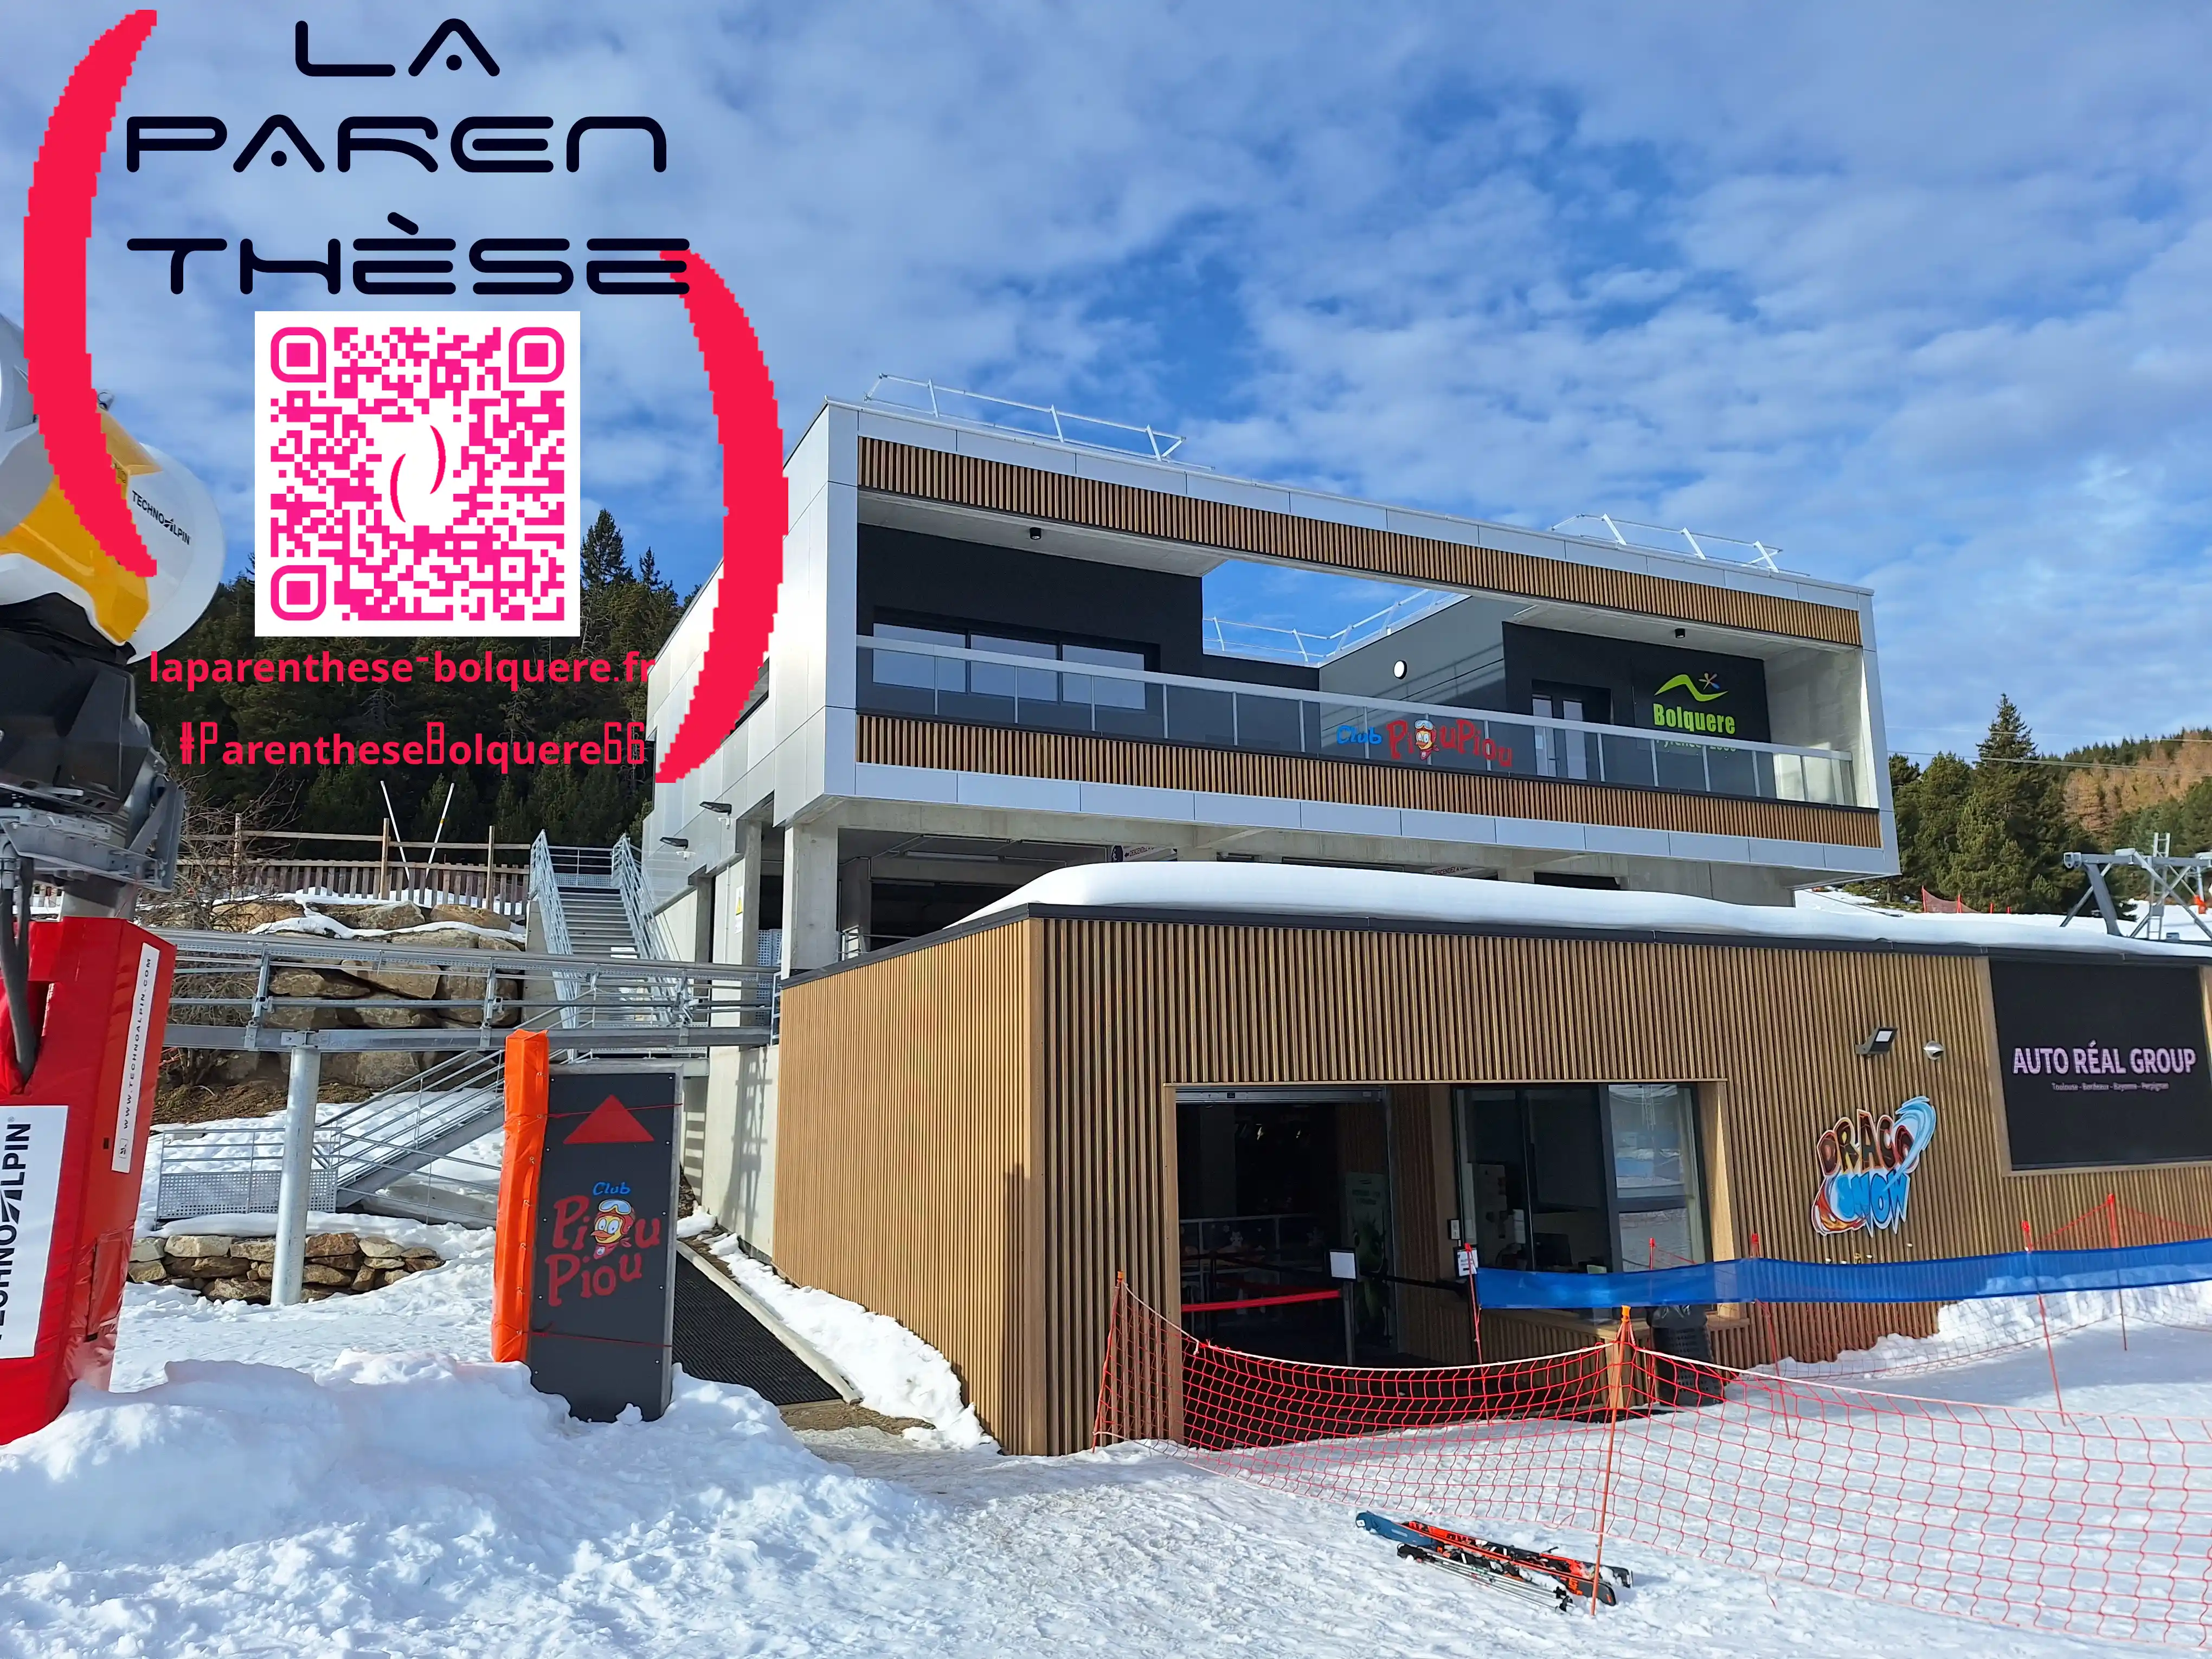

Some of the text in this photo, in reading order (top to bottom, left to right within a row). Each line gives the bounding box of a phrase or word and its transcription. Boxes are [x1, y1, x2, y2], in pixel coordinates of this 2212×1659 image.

[1336, 725, 1382, 745] Club
[1653, 703, 1735, 735] Bolquere
[124, 957, 152, 1130] WWW.TECHNOALPIN.COM
[2013, 1039, 2197, 1074] AUTO RÉAL GROUP
[593, 1182, 631, 1195] Club
[1836, 1170, 1909, 1230] SNOW
[544, 1253, 642, 1307] Piou
